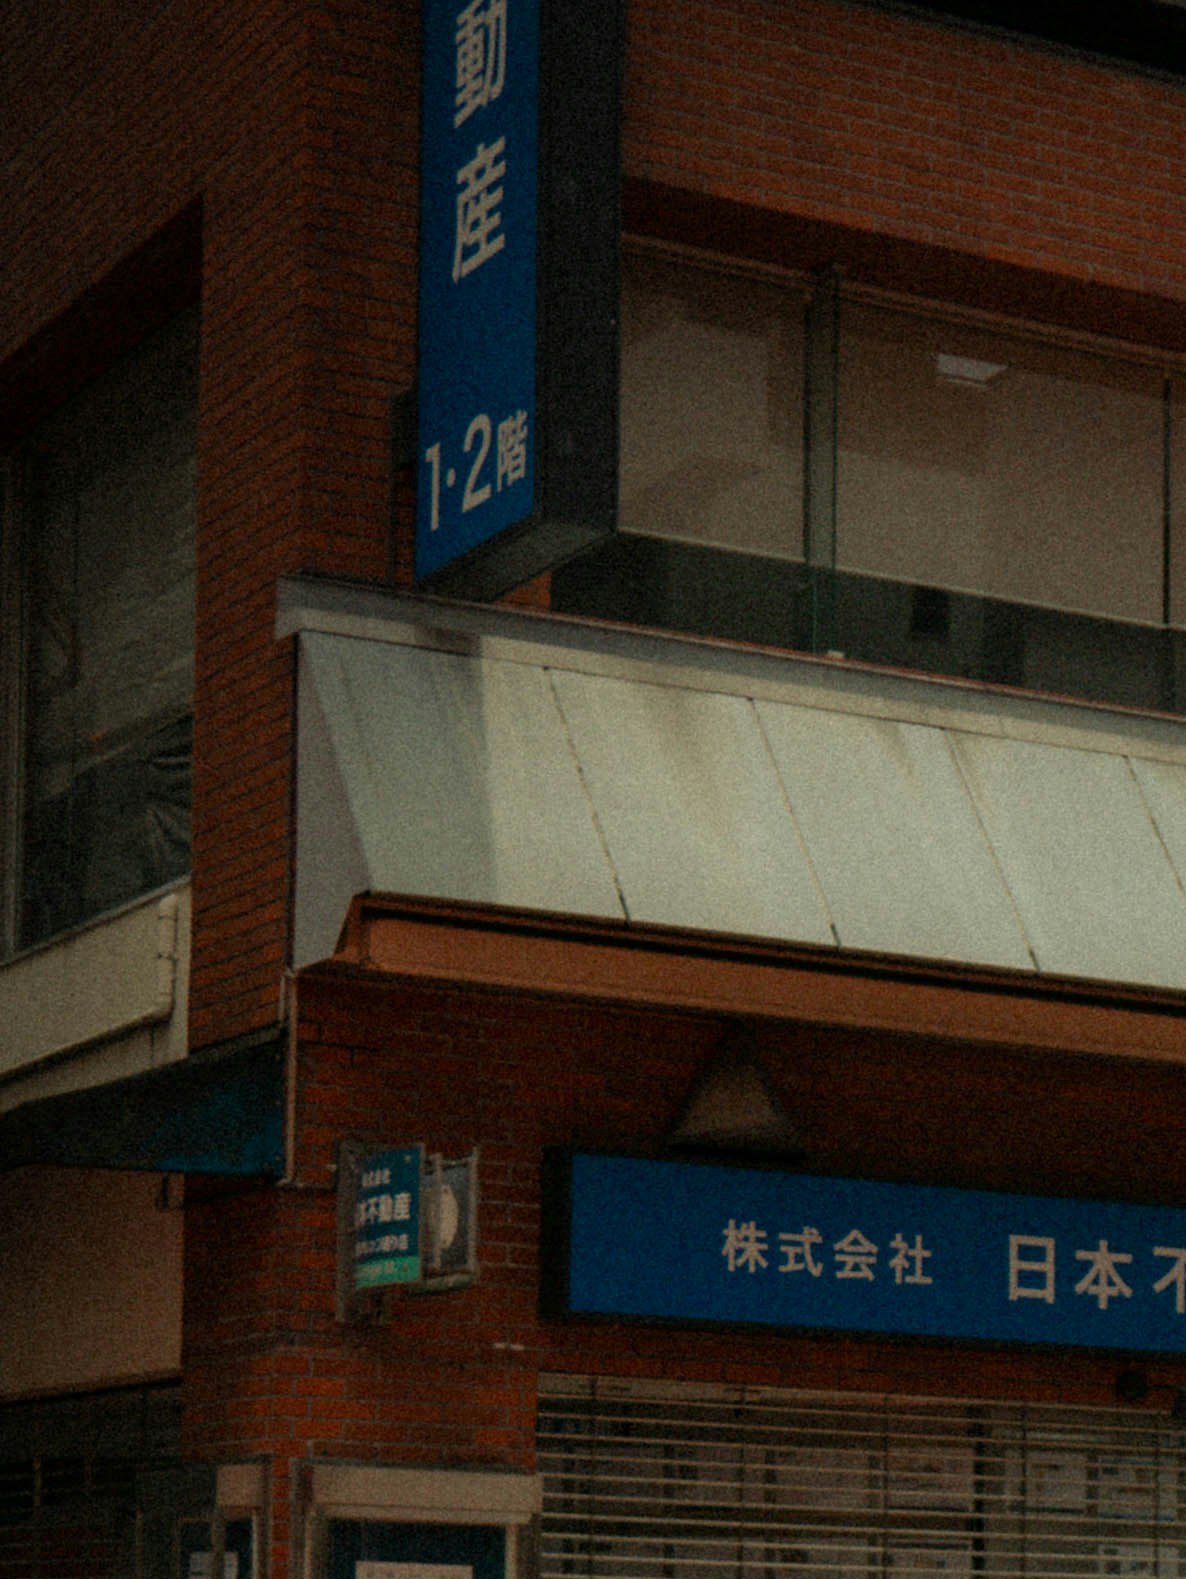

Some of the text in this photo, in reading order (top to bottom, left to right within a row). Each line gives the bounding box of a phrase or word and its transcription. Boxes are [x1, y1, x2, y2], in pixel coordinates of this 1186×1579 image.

[453, 0, 507, 283] 動産
[721, 1218, 934, 1286] 株式会社
